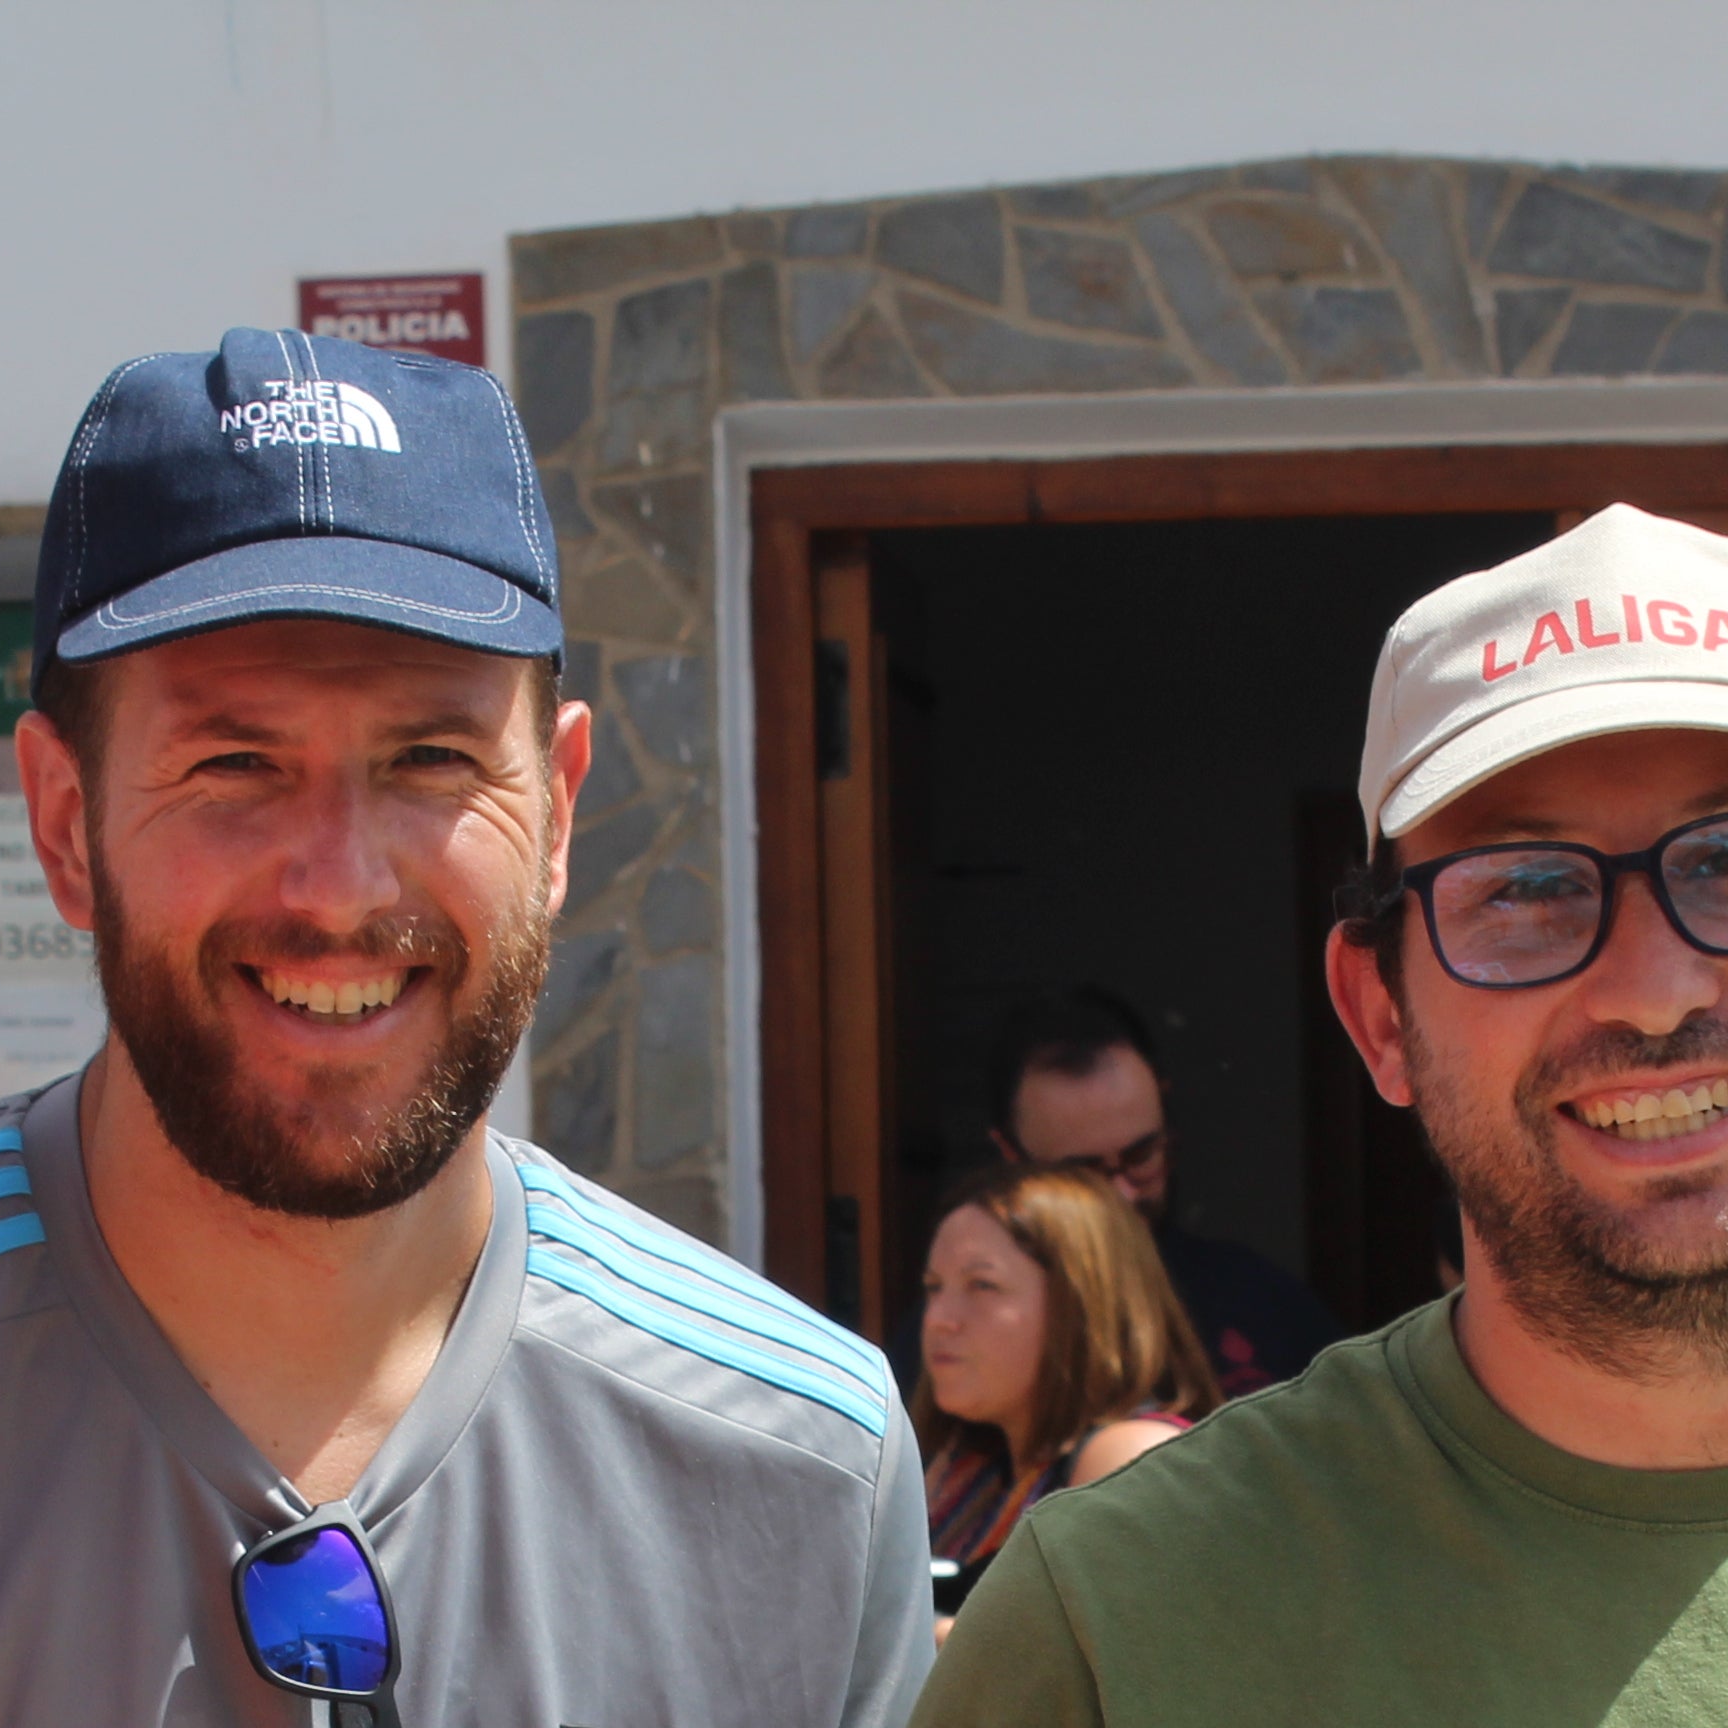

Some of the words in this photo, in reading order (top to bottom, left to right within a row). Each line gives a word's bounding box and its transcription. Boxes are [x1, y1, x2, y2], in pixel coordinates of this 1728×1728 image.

[314, 310, 470, 345] POLICIA
[265, 379, 335, 401] THE
[221, 400, 340, 433] NORTH
[251, 420, 342, 449] FACE
